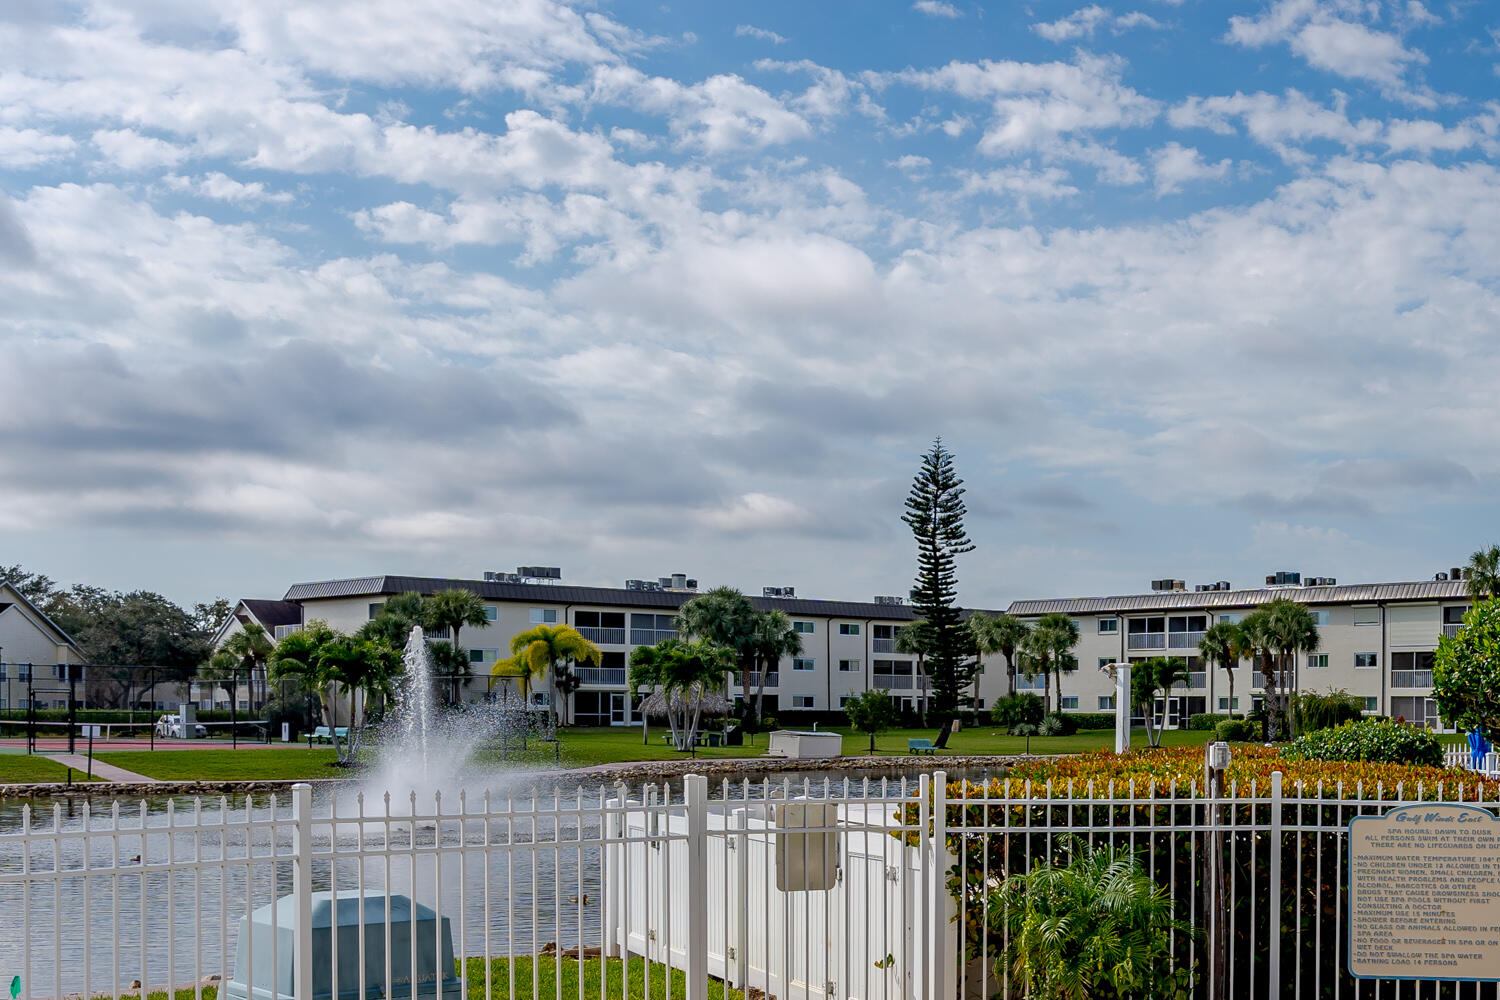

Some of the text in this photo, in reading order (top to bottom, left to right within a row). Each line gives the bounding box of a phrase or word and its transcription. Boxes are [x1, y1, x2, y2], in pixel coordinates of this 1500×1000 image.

[1396, 812, 1482, 824] Gulf Winds East
